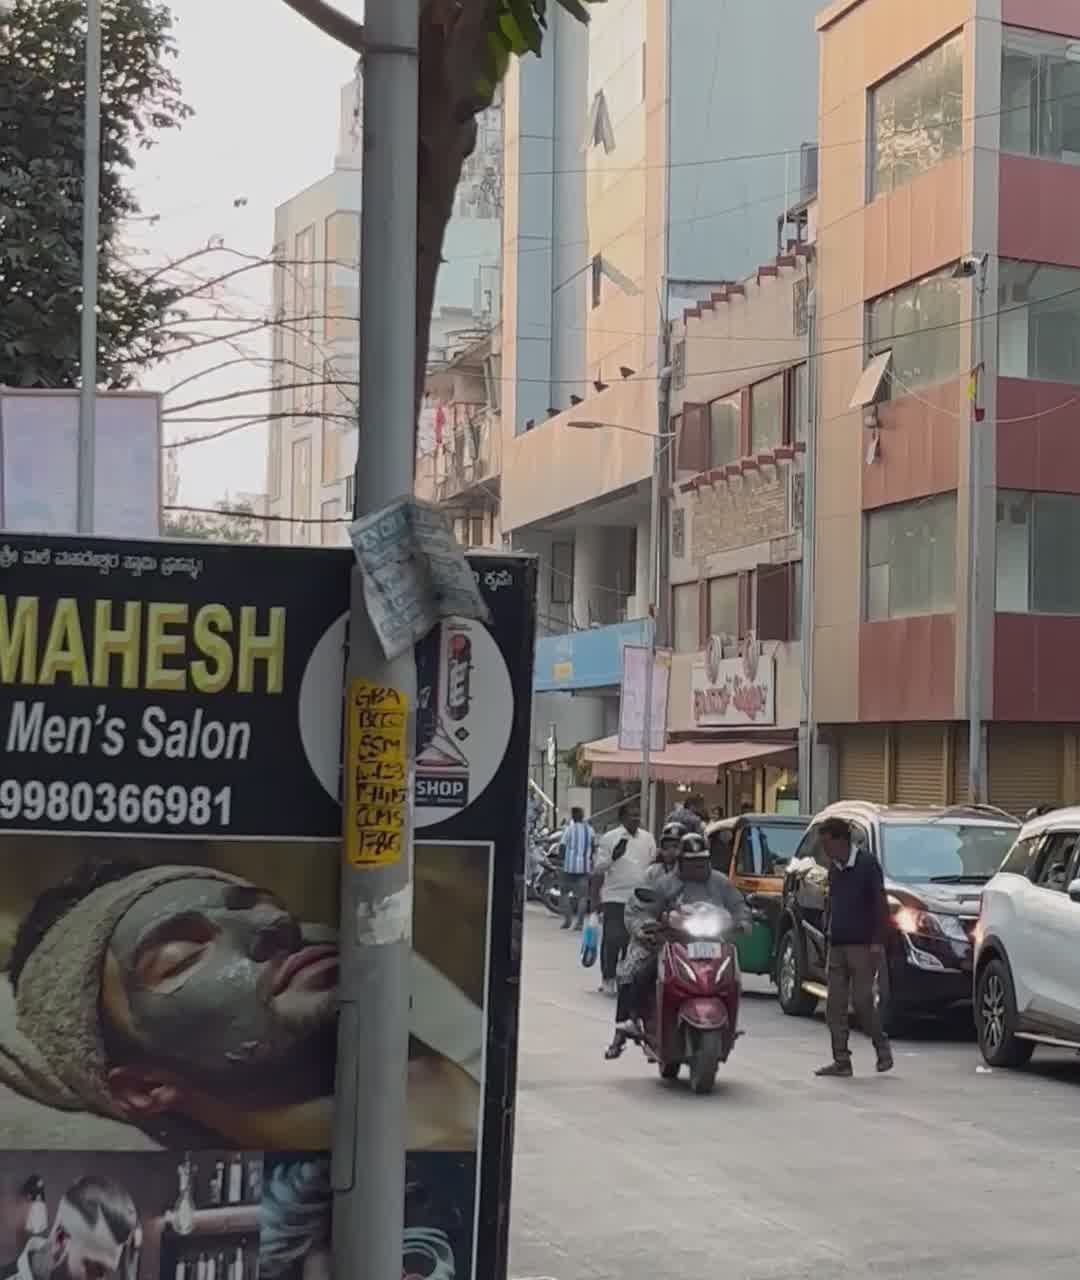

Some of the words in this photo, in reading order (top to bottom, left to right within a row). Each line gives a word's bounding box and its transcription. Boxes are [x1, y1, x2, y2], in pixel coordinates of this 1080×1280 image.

[0, 594, 287, 694] MAHESH
[6, 700, 127, 757] Men's
[137, 705, 251, 760] Salon
[0, 779, 233, 826] 9980366981
[415, 779, 465, 797] SHOP
